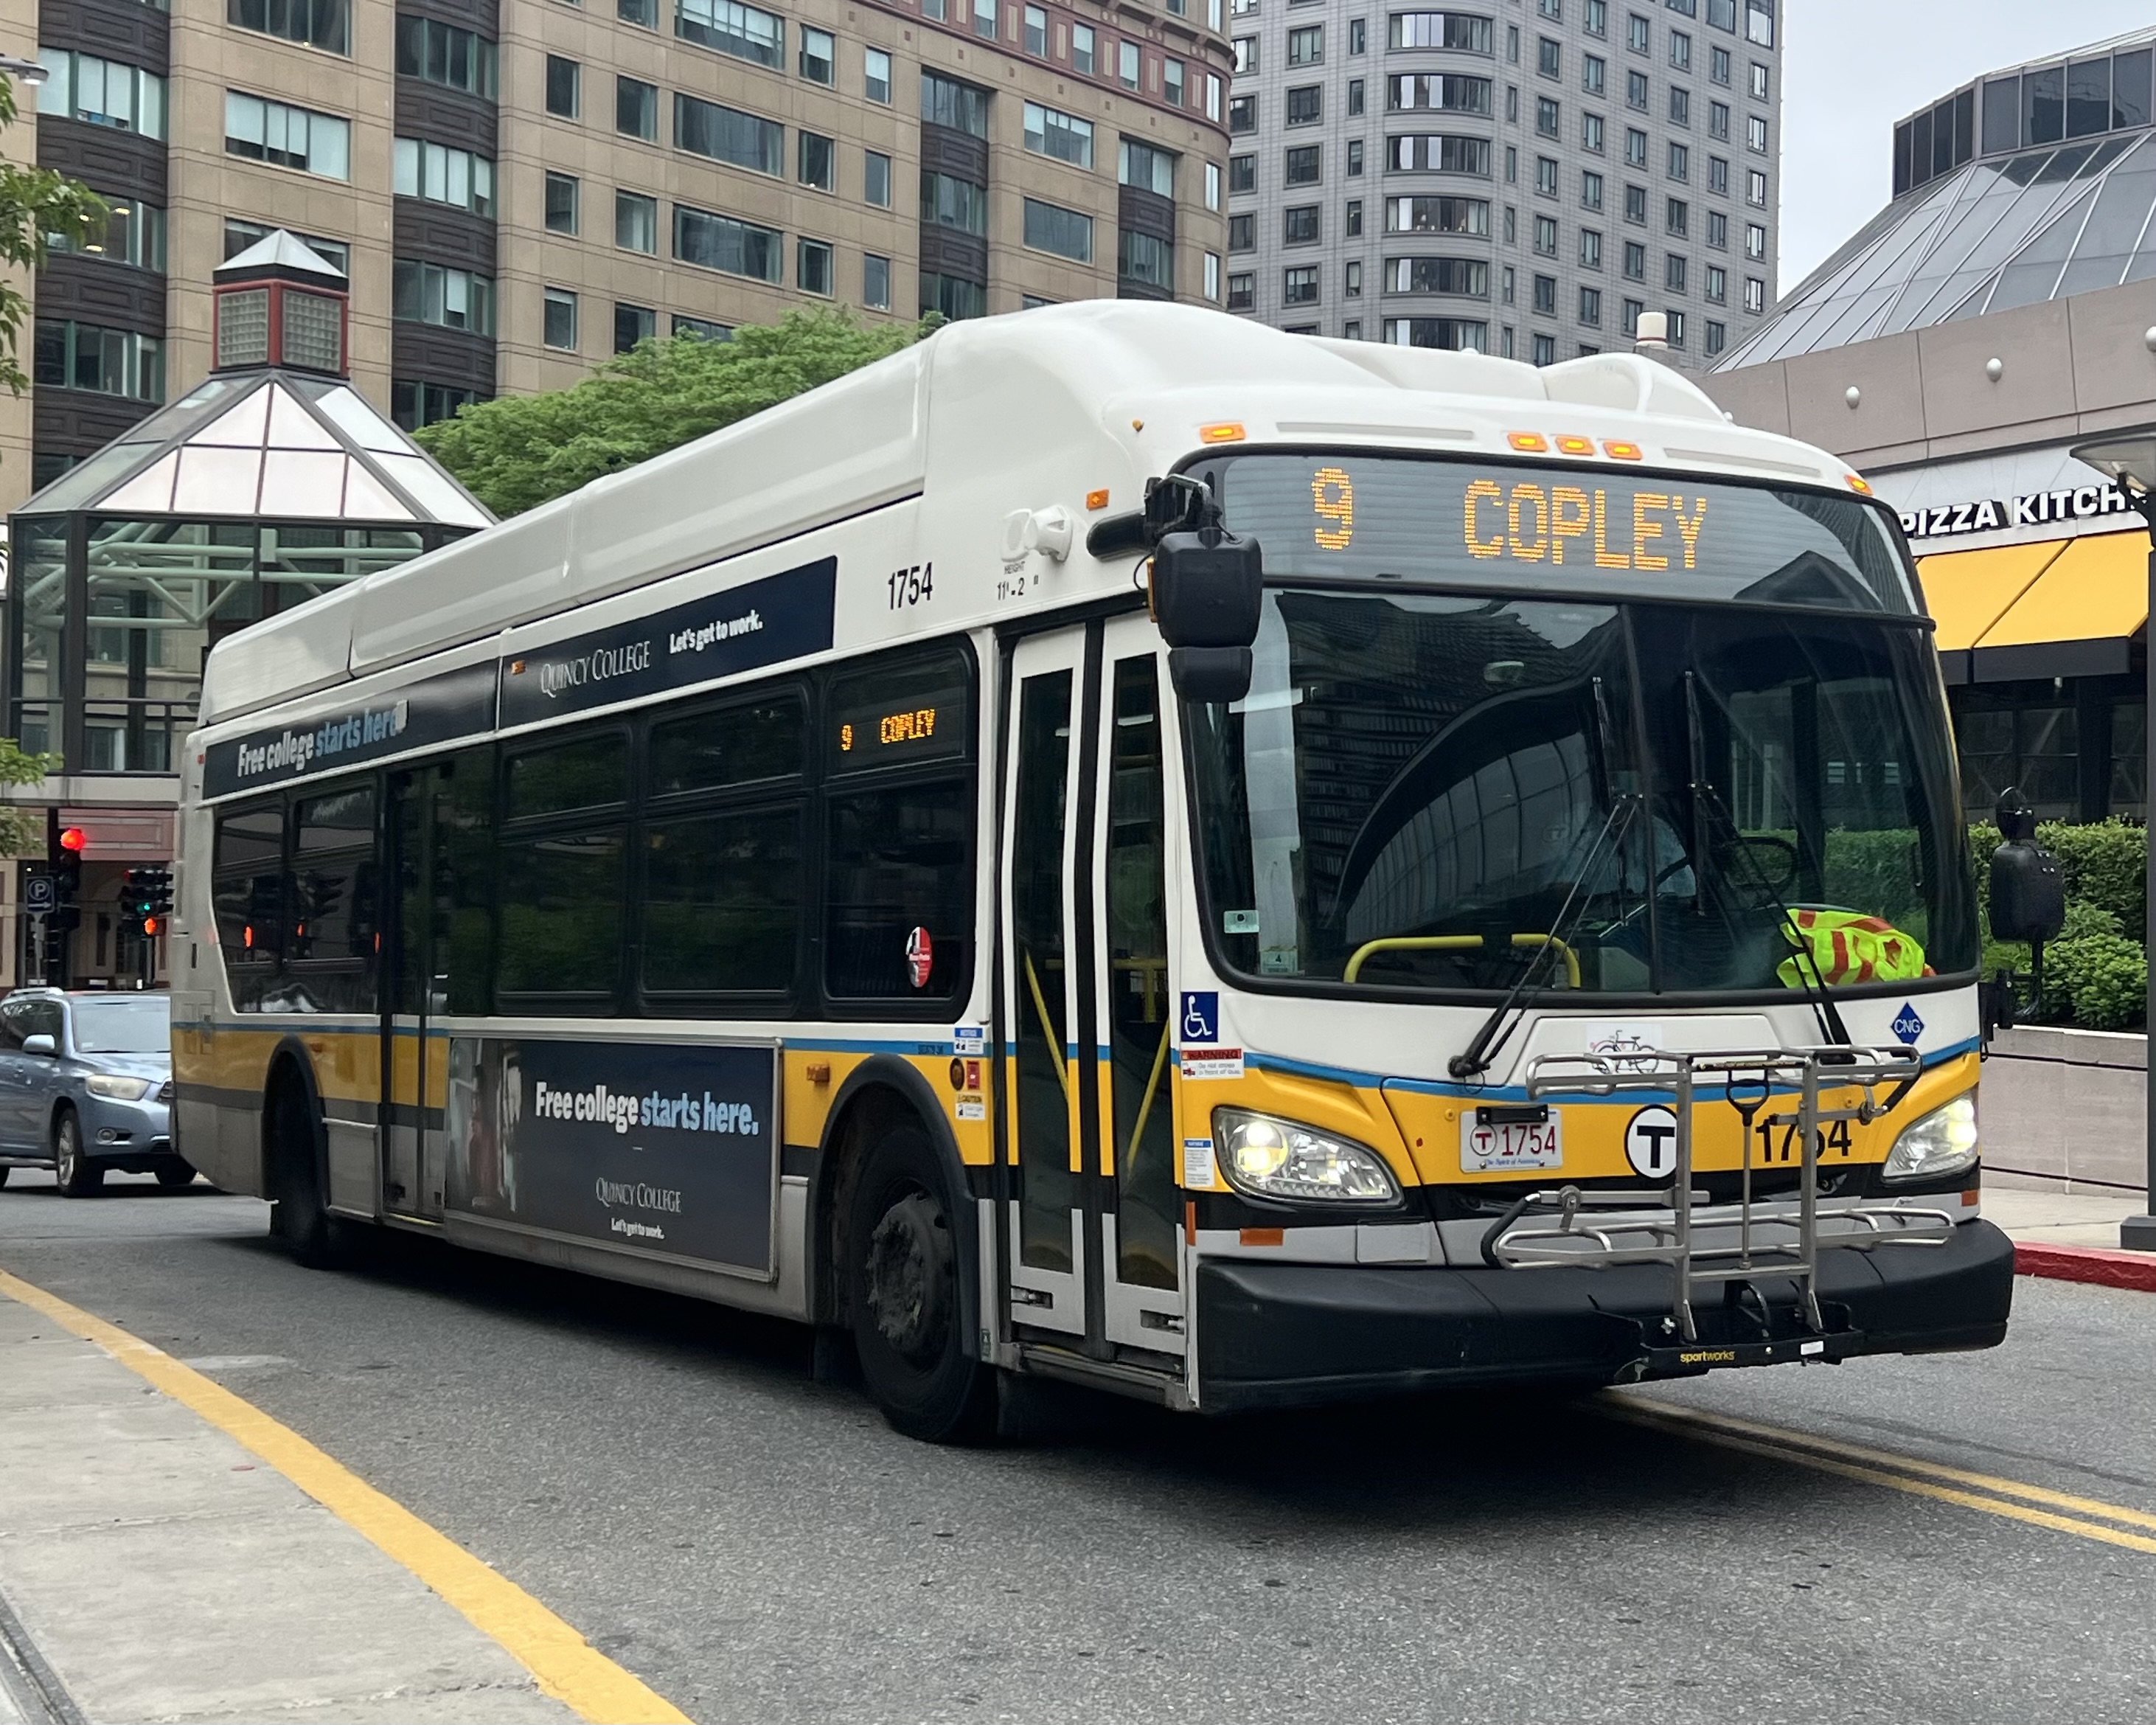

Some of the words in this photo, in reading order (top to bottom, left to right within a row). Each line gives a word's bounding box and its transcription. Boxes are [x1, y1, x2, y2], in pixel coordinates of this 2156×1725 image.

[1312, 467, 1354, 550] 9
[1464, 479, 1708, 572] COPLEY
[1899, 499, 1999, 537] PIZZA
[888, 562, 933, 611] 1754
[670, 628, 695, 654] Let's
[696, 623, 714, 651] get
[716, 619, 728, 640] to
[728, 609, 763, 636] work.
[237, 743, 265, 777] Free
[266, 730, 314, 771] college
[315, 715, 361, 757] starts
[841, 724, 852, 751] 9
[1894, 1018, 1921, 1034] CNG
[535, 1081, 573, 1120] Free
[574, 1084, 639, 1134] college
[640, 1090, 701, 1131] starts
[703, 1091, 760, 1136] here.
[1475, 1132, 1492, 1150] T
[1502, 1125, 1557, 1156] 1754
[1636, 1125, 1676, 1169] T
[1680, 1351, 1735, 1364] sportworks
